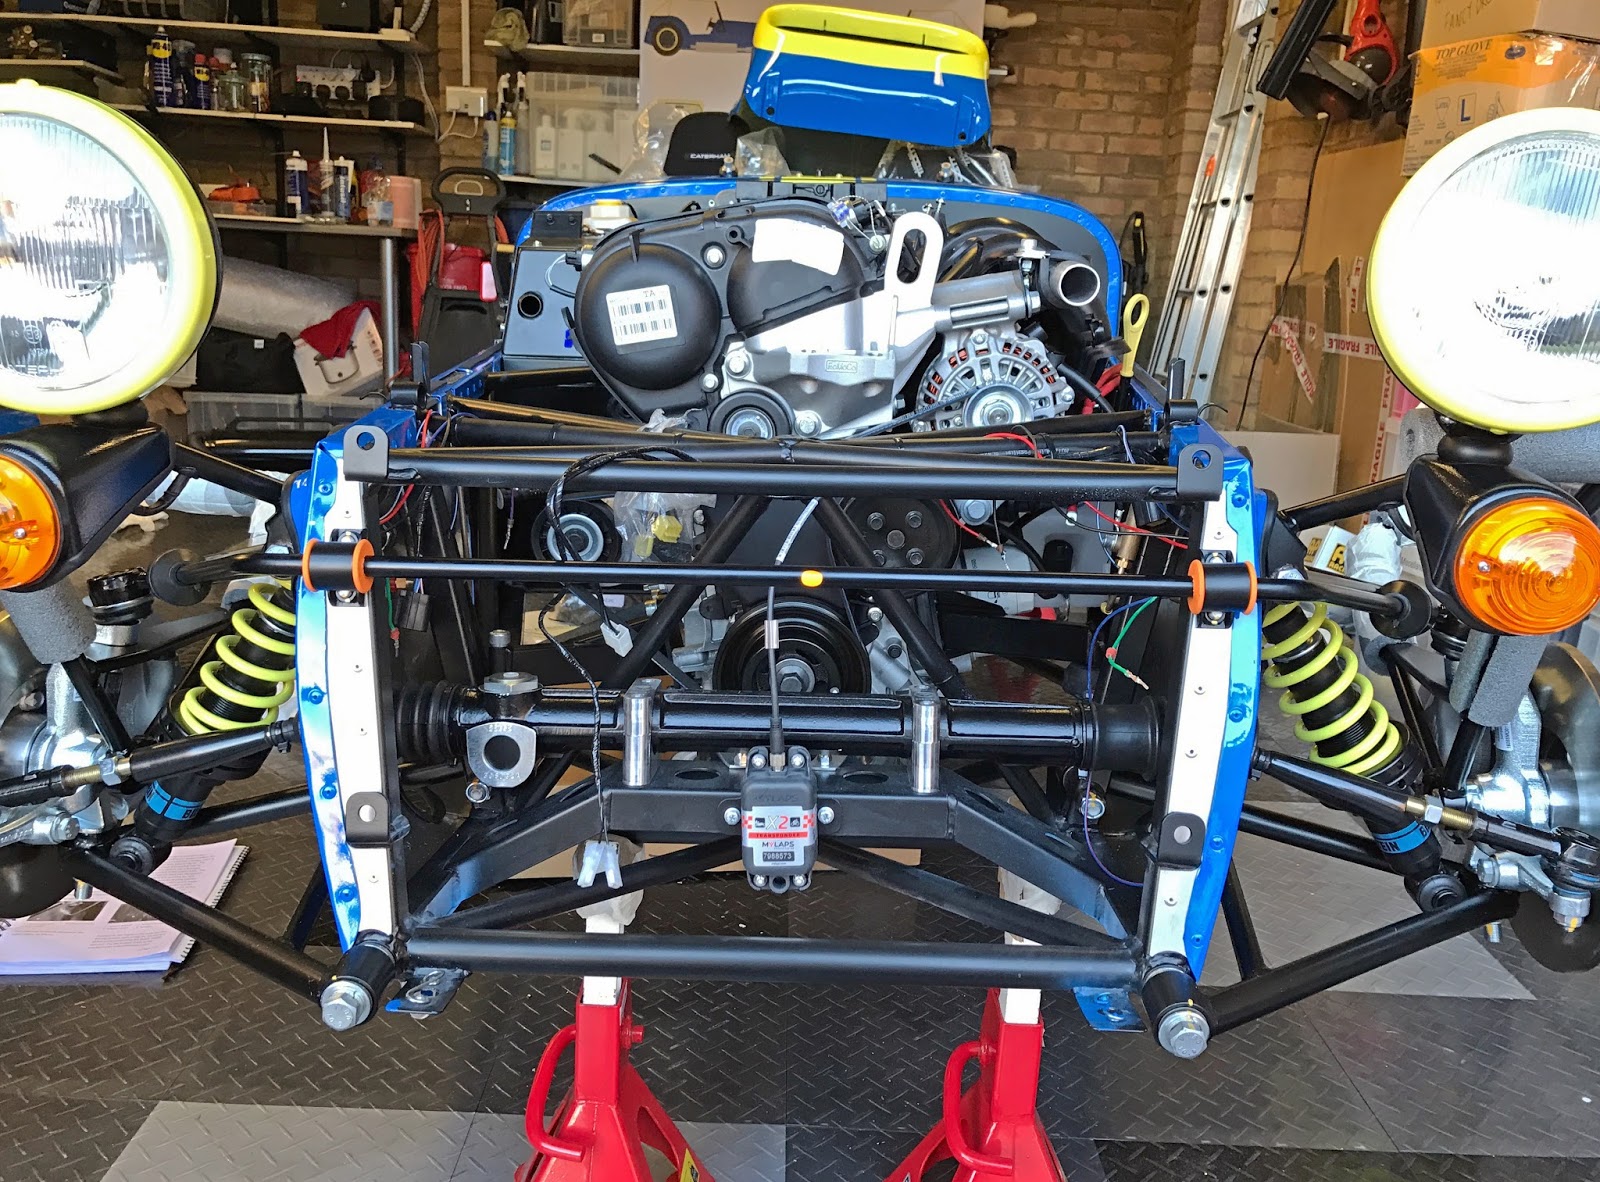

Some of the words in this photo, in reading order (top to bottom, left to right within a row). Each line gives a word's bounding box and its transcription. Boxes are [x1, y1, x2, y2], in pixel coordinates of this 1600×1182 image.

[1436, 47, 1456, 60] TOP
[1456, 39, 1492, 57] GLOVE
[1460, 98, 1471, 122] L
[1328, 338, 1360, 354] FRAGILE
[766, 815, 789, 830] X2
